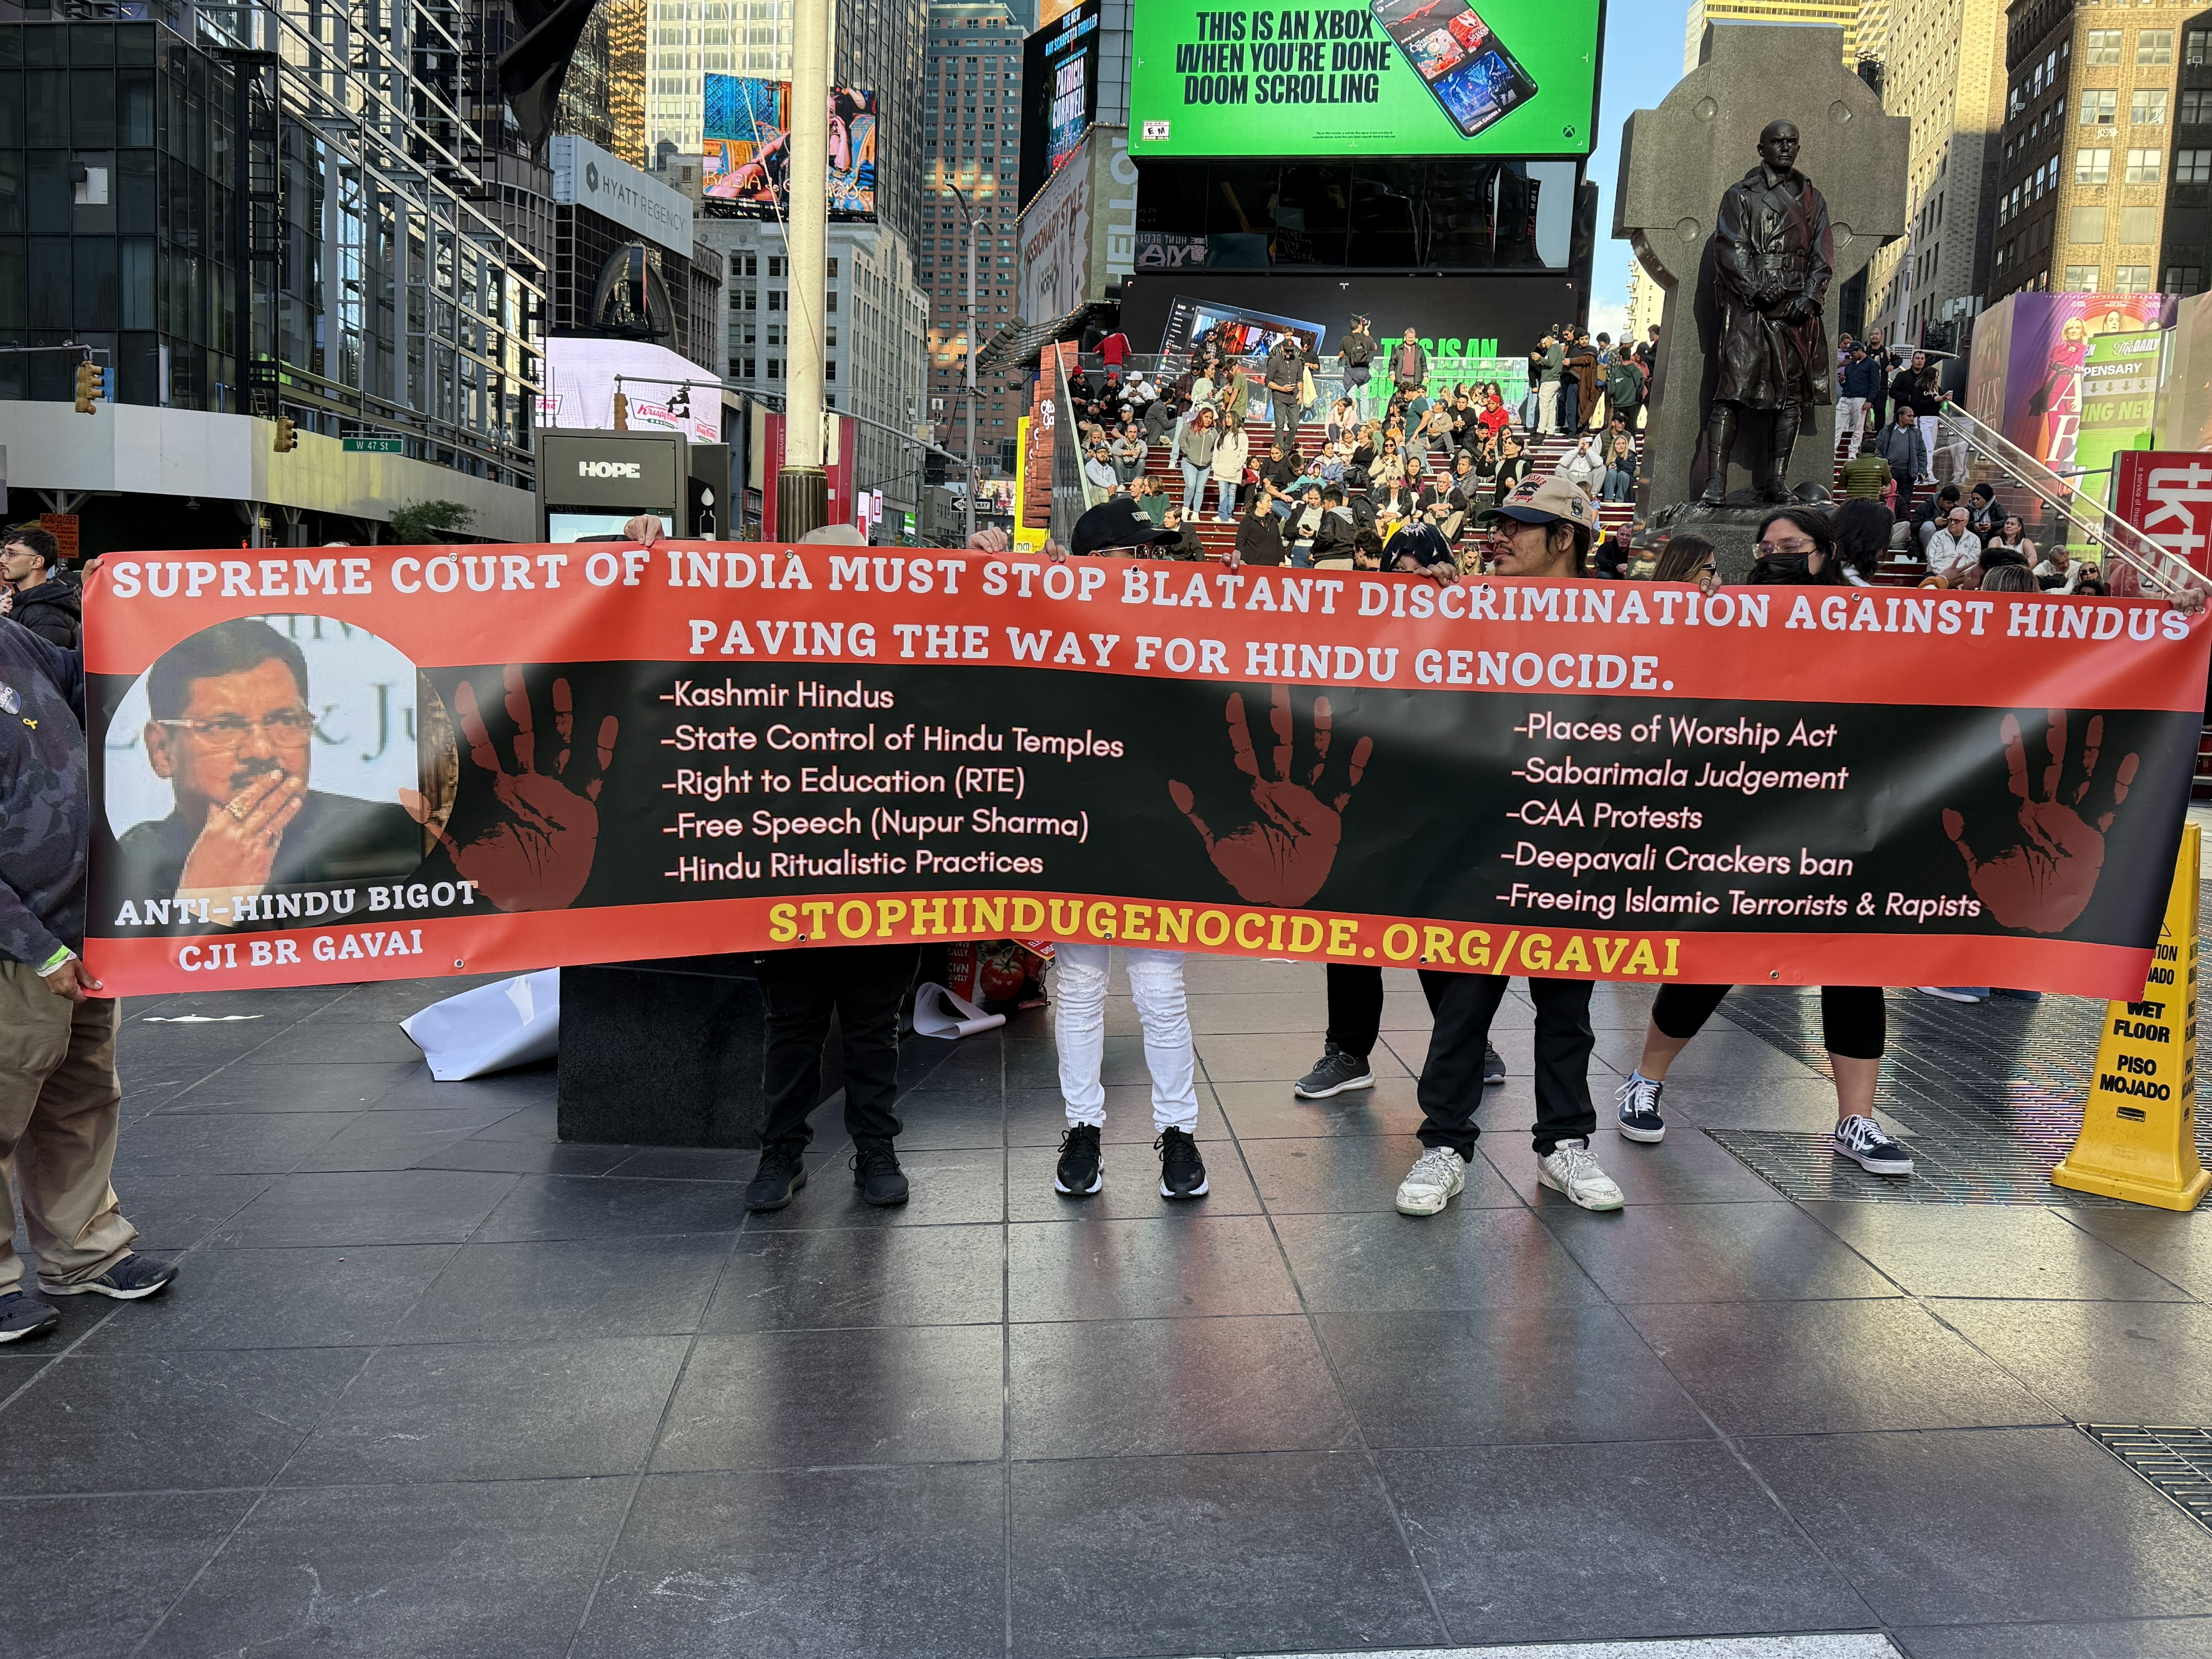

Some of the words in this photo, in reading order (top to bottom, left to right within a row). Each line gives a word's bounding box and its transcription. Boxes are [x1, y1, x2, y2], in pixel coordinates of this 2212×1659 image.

[1071, 7, 1081, 24] NEW
[1196, 11, 1246, 41] THIS
[1251, 11, 1273, 40] IS
[1278, 10, 1309, 40] AN
[1313, 9, 1373, 40] XBOX
[1176, 43, 1245, 73] WHEN
[1250, 42, 1326, 72] YOU'RE
[1332, 41, 1391, 72] DONE
[1056, 56, 1084, 99] PATRICIA
[1184, 75, 1249, 105] DOOM
[1255, 74, 1379, 104] SCROLLING
[1053, 86, 1085, 129] CORNWELL
[706, 170, 761, 191] KASIA
[603, 175, 638, 208] HYATT
[641, 195, 685, 232] REGENCY
[1060, 179, 1084, 230] STYLE
[1437, 338, 1461, 369] IS
[1466, 338, 1498, 369] AN
[356, 441, 364, 450] W
[367, 441, 376, 450] 47
[380, 442, 388, 450] St
[579, 461, 640, 479] HOPE
[41, 514, 56, 524] ROAD
[57, 515, 77, 525] CLOSED
[113, 558, 371, 598] SUPREME
[392, 553, 567, 593] COURT
[586, 550, 649, 586] OF
[668, 550, 812, 589] INDIA
[830, 556, 966, 594] MUST
[983, 562, 1106, 601] STOP
[1121, 568, 1343, 614] BLATANT
[1359, 582, 1771, 628] DISCRIMINATION
[1785, 596, 1993, 635] AGAINST
[2007, 603, 2189, 641] HINDUS
[689, 620, 875, 656] PAVING
[893, 625, 988, 658] THE
[1006, 627, 1120, 666] WAY
[1135, 636, 1229, 673] FOR
[1245, 642, 1399, 681] HINDU
[1415, 649, 1673, 690] GENOCIDE.
[799, 680, 893, 708] Hindus
[767, 724, 874, 750] Control
[885, 724, 914, 750] of
[925, 724, 1002, 750] Hindu
[1012, 727, 1123, 762] Temples
[1631, 714, 1661, 742] of
[1669, 714, 1779, 753] Worship
[1787, 718, 1837, 746] Act
[761, 770, 790, 792] to
[802, 766, 945, 792] Education
[956, 766, 1024, 799] (RTE)
[1695, 761, 1849, 795] Judgement
[752, 808, 860, 842] Speech
[872, 807, 963, 840] (Nupur
[972, 807, 1087, 843] Sharma)
[1594, 803, 1702, 828] Protests
[771, 849, 906, 877] Ritualistic
[917, 850, 1042, 873] Practices
[1666, 845, 1790, 874] Crackers
[1800, 848, 1853, 875] ban
[115, 885, 355, 926] ANTI-HINDU
[368, 881, 477, 910] BIGOT
[1626, 886, 1719, 914] Islamic
[1729, 890, 1847, 915] Terrorists
[1856, 893, 1875, 915] &
[1886, 893, 1980, 923] Rapists
[179, 944, 237, 971] CJI
[250, 939, 301, 966] BR
[313, 929, 422, 961] GAVAI
[770, 897, 1680, 975] STOPHINDUGENOCIDE.ORG/GAVAI
[2127, 1001, 2166, 1019] WET
[2113, 1018, 2170, 1043] FLOOR
[2117, 1054, 2157, 1076] PISO
[2099, 1073, 2171, 1101] MOJADO
